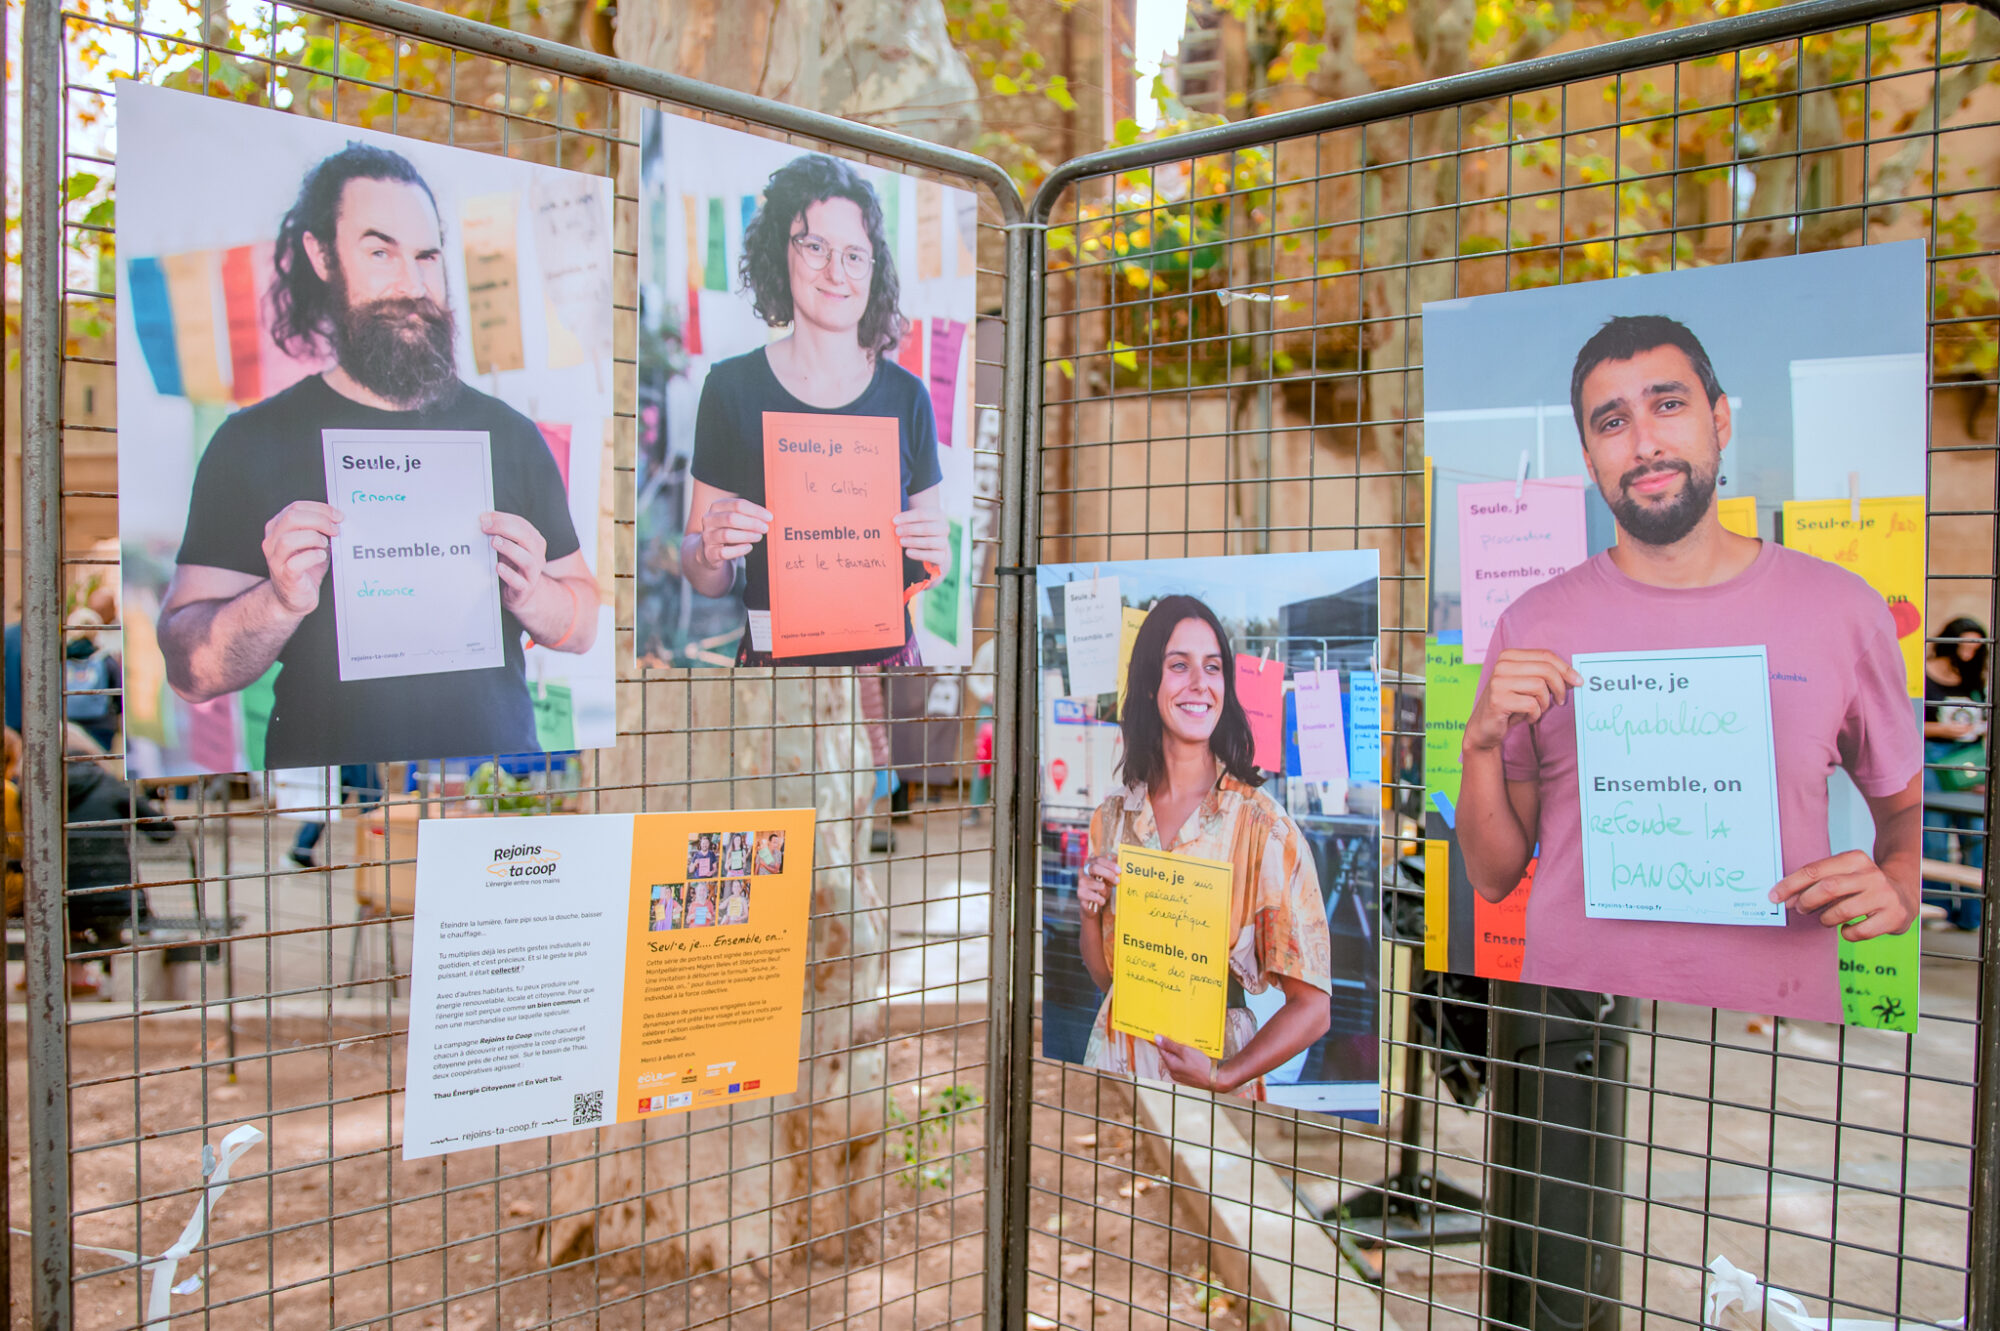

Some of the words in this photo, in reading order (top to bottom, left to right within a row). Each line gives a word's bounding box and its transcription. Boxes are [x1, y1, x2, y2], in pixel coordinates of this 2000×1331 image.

[778, 438, 826, 455] Seule,
[828, 439, 843, 457] je
[342, 455, 401, 472] Seule,
[404, 455, 421, 472] je
[804, 472, 817, 493] le
[352, 491, 407, 504] renonce
[1470, 503, 1513, 515] Seule,
[1515, 501, 1528, 514] je
[1859, 516, 1875, 531] je
[784, 526, 860, 541] Ensemble,
[863, 528, 881, 539] on
[353, 542, 445, 561] Ensemble,
[450, 545, 471, 560] on
[785, 555, 805, 570] est
[816, 553, 829, 570] le
[836, 552, 887, 569] tsunami
[1475, 566, 1546, 581] Ensemble,
[357, 580, 415, 598] dénonce
[1668, 673, 1690, 693] je
[1594, 776, 1707, 793] Ensemble,
[1714, 779, 1742, 792] on
[493, 844, 541, 860] Rejoins
[509, 865, 523, 876] ta
[524, 862, 556, 875] coop
[1170, 869, 1185, 884] je
[1123, 933, 1189, 962] Ensemble,
[1191, 951, 1208, 965] on
[1875, 964, 1897, 976] on
[452, 1088, 479, 1096] Énergie
[480, 1083, 515, 1092] Citoyenne
[462, 1121, 537, 1140] rejoins-ta-coop.fr
